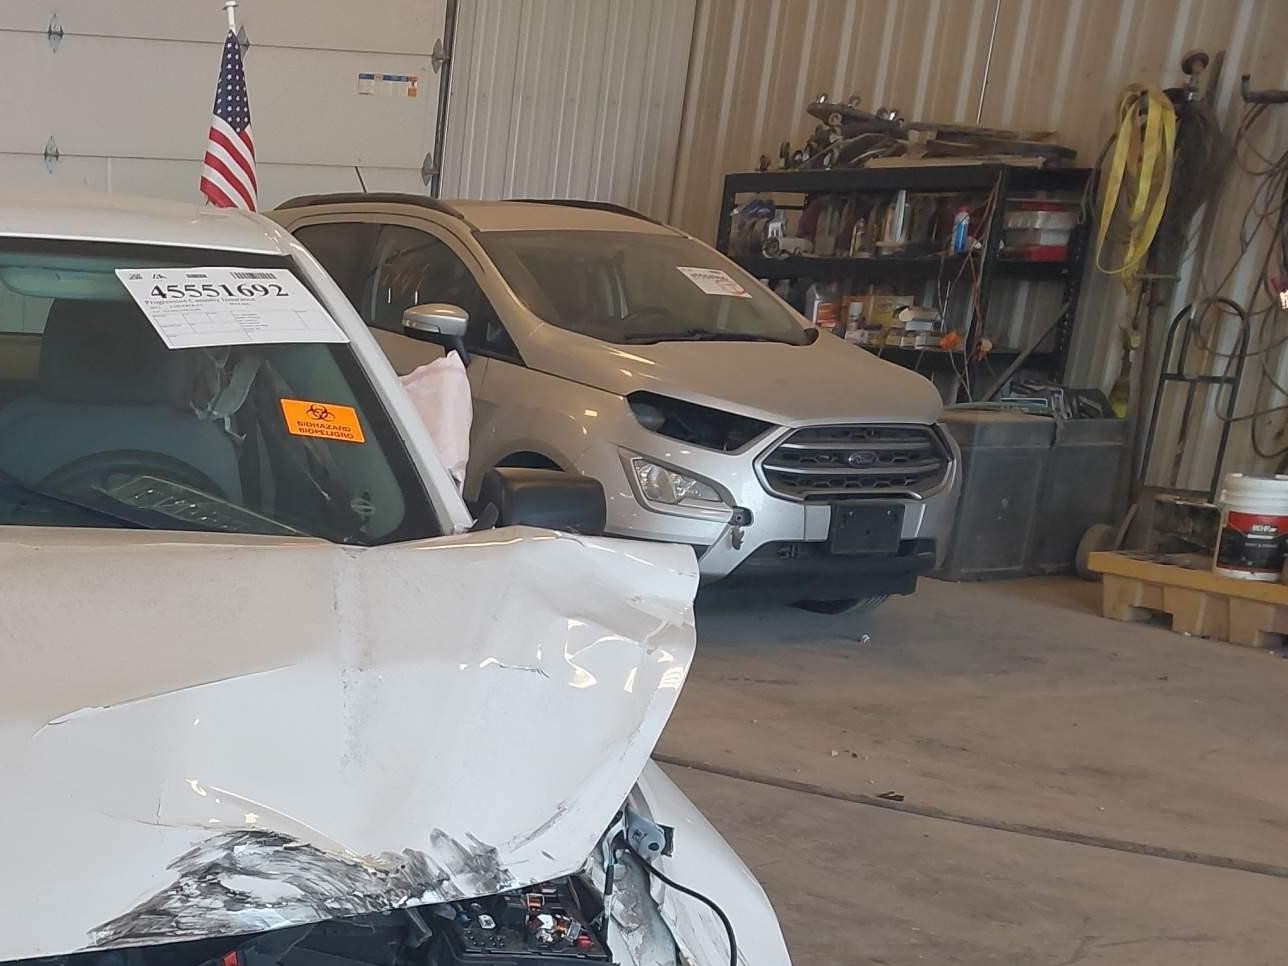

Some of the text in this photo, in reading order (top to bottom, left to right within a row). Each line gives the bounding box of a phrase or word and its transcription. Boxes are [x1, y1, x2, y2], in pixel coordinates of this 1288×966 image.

[151, 284, 289, 298] 45551692
[297, 421, 351, 432] BIOHAZARD
[298, 428, 354, 439] BIOPELIGRO
